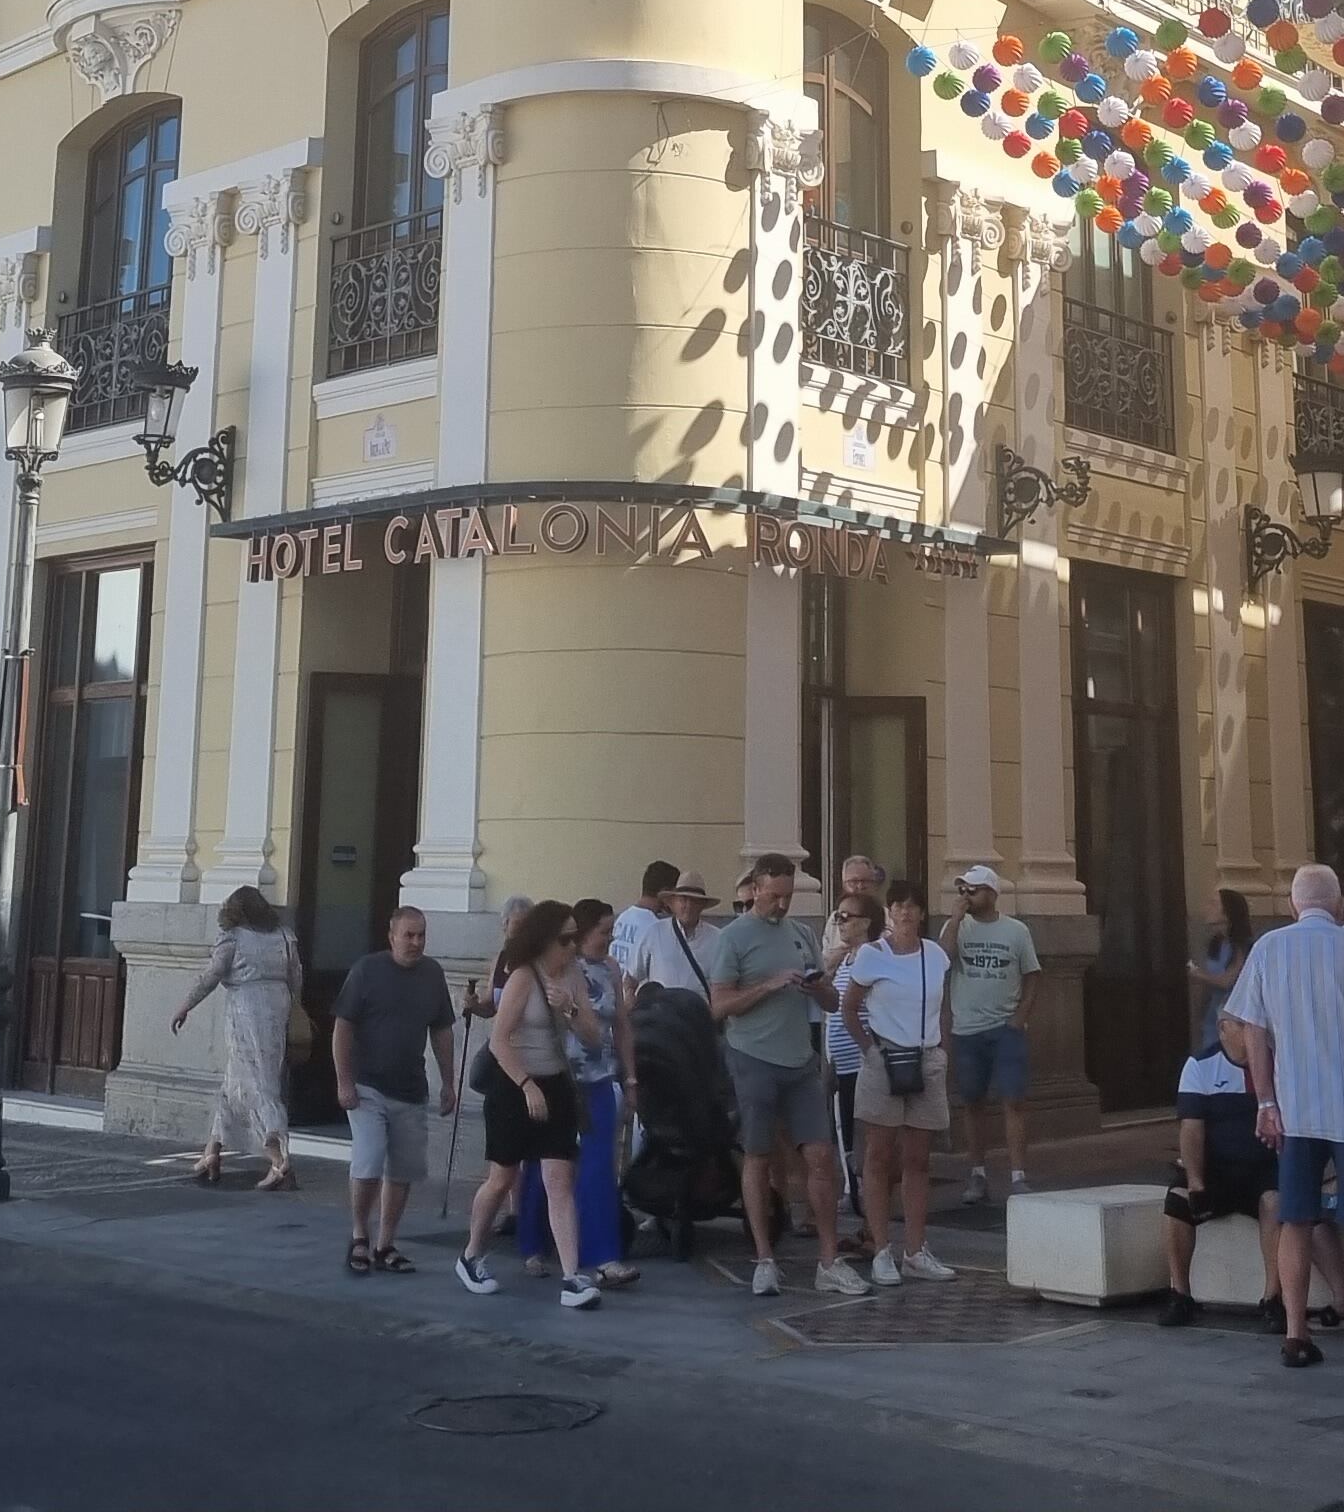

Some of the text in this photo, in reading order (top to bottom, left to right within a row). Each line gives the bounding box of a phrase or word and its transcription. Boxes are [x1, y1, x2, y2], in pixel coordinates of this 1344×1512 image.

[246, 501, 891, 584] HOTEL CATALONIA RONDA
[974, 954, 1000, 969] 1973
